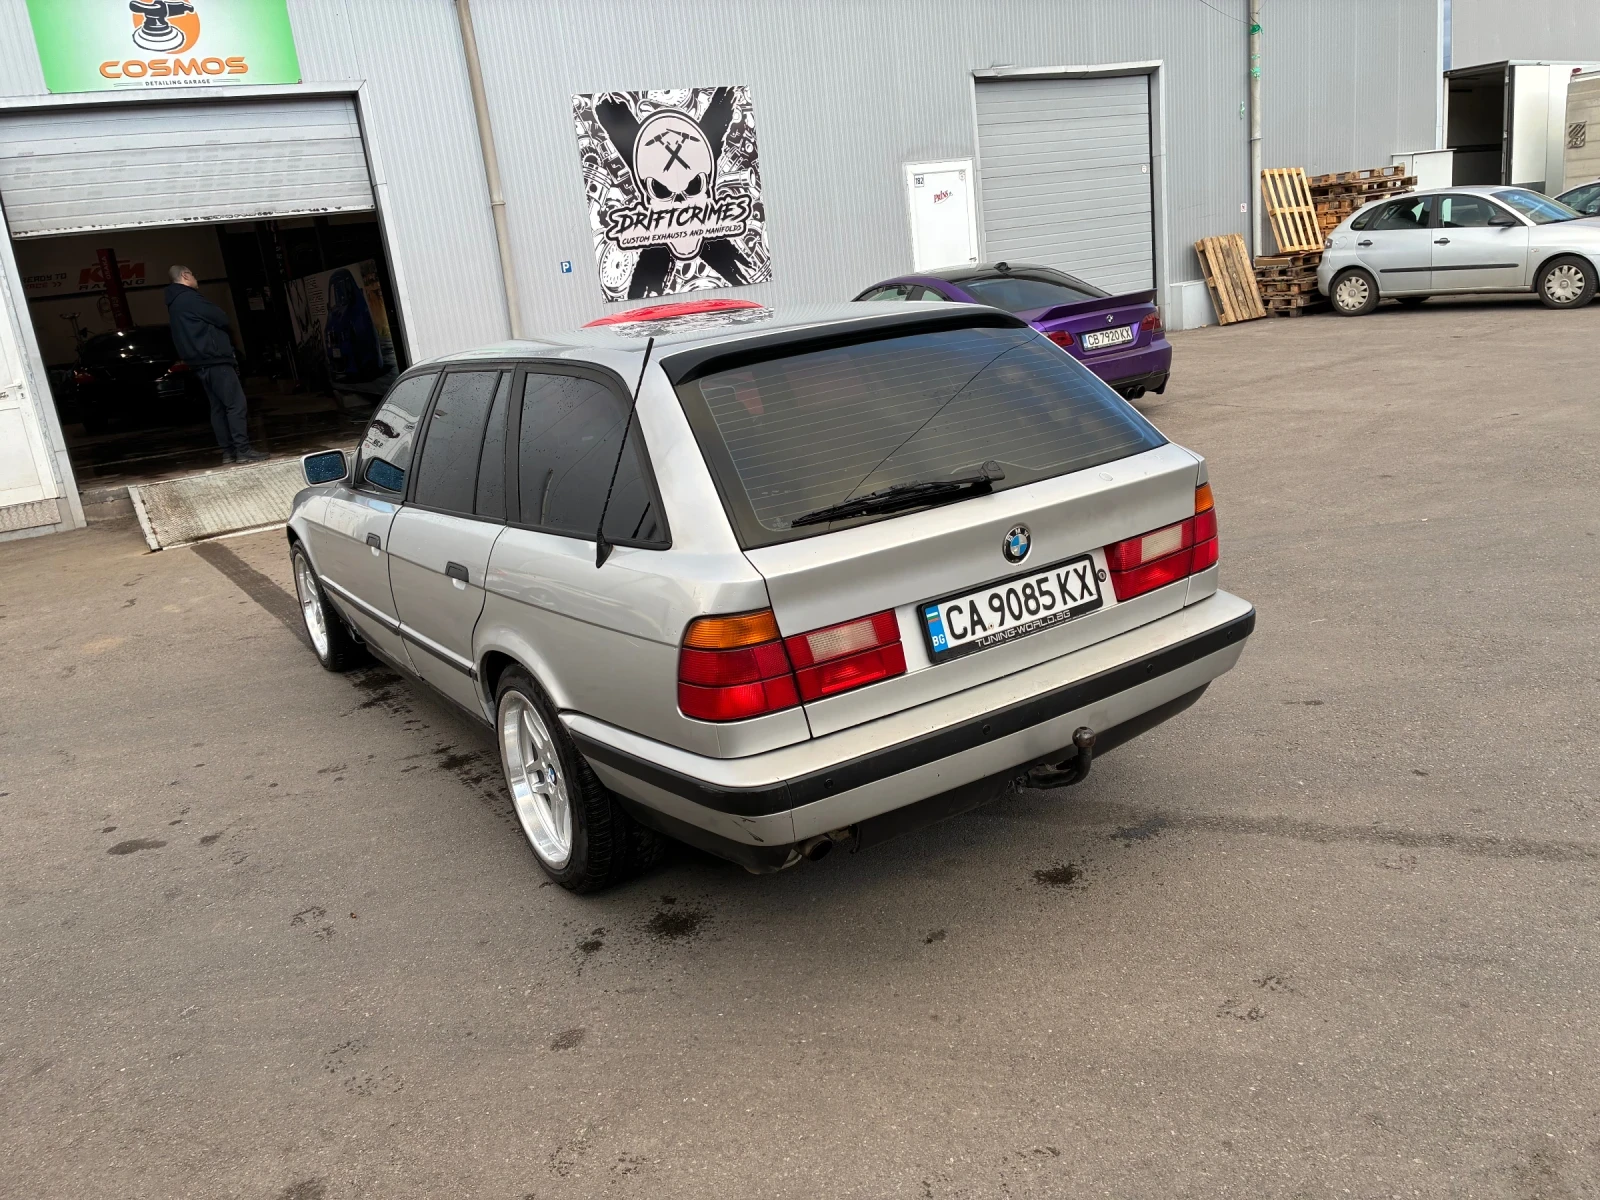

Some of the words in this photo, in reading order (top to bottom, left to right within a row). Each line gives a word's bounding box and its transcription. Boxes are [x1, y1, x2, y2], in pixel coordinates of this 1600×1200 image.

[99, 56, 249, 79] COSMOS
[145, 79, 182, 87] DETAILING
[615, 200, 747, 235] DRIFTCRIMES
[622, 235, 650, 245] CUSTOM
[652, 231, 688, 241] EXHAUSTS
[689, 229, 704, 237] AND
[705, 224, 742, 235] MANIFOLDS
[562, 262, 570, 273] P
[54, 272, 67, 280] TO
[79, 279, 145, 291] RANG
[1087, 334, 1100, 346] CB
[1100, 330, 1120, 344] 7920
[1120, 327, 1131, 340] KX
[1006, 527, 1029, 541] BMW
[946, 600, 988, 640] CA
[988, 577, 1056, 627] 9085
[1056, 565, 1096, 606] KX
[975, 610, 1071, 647] TUNING-WORLD.BG
[932, 634, 946, 647] BG
